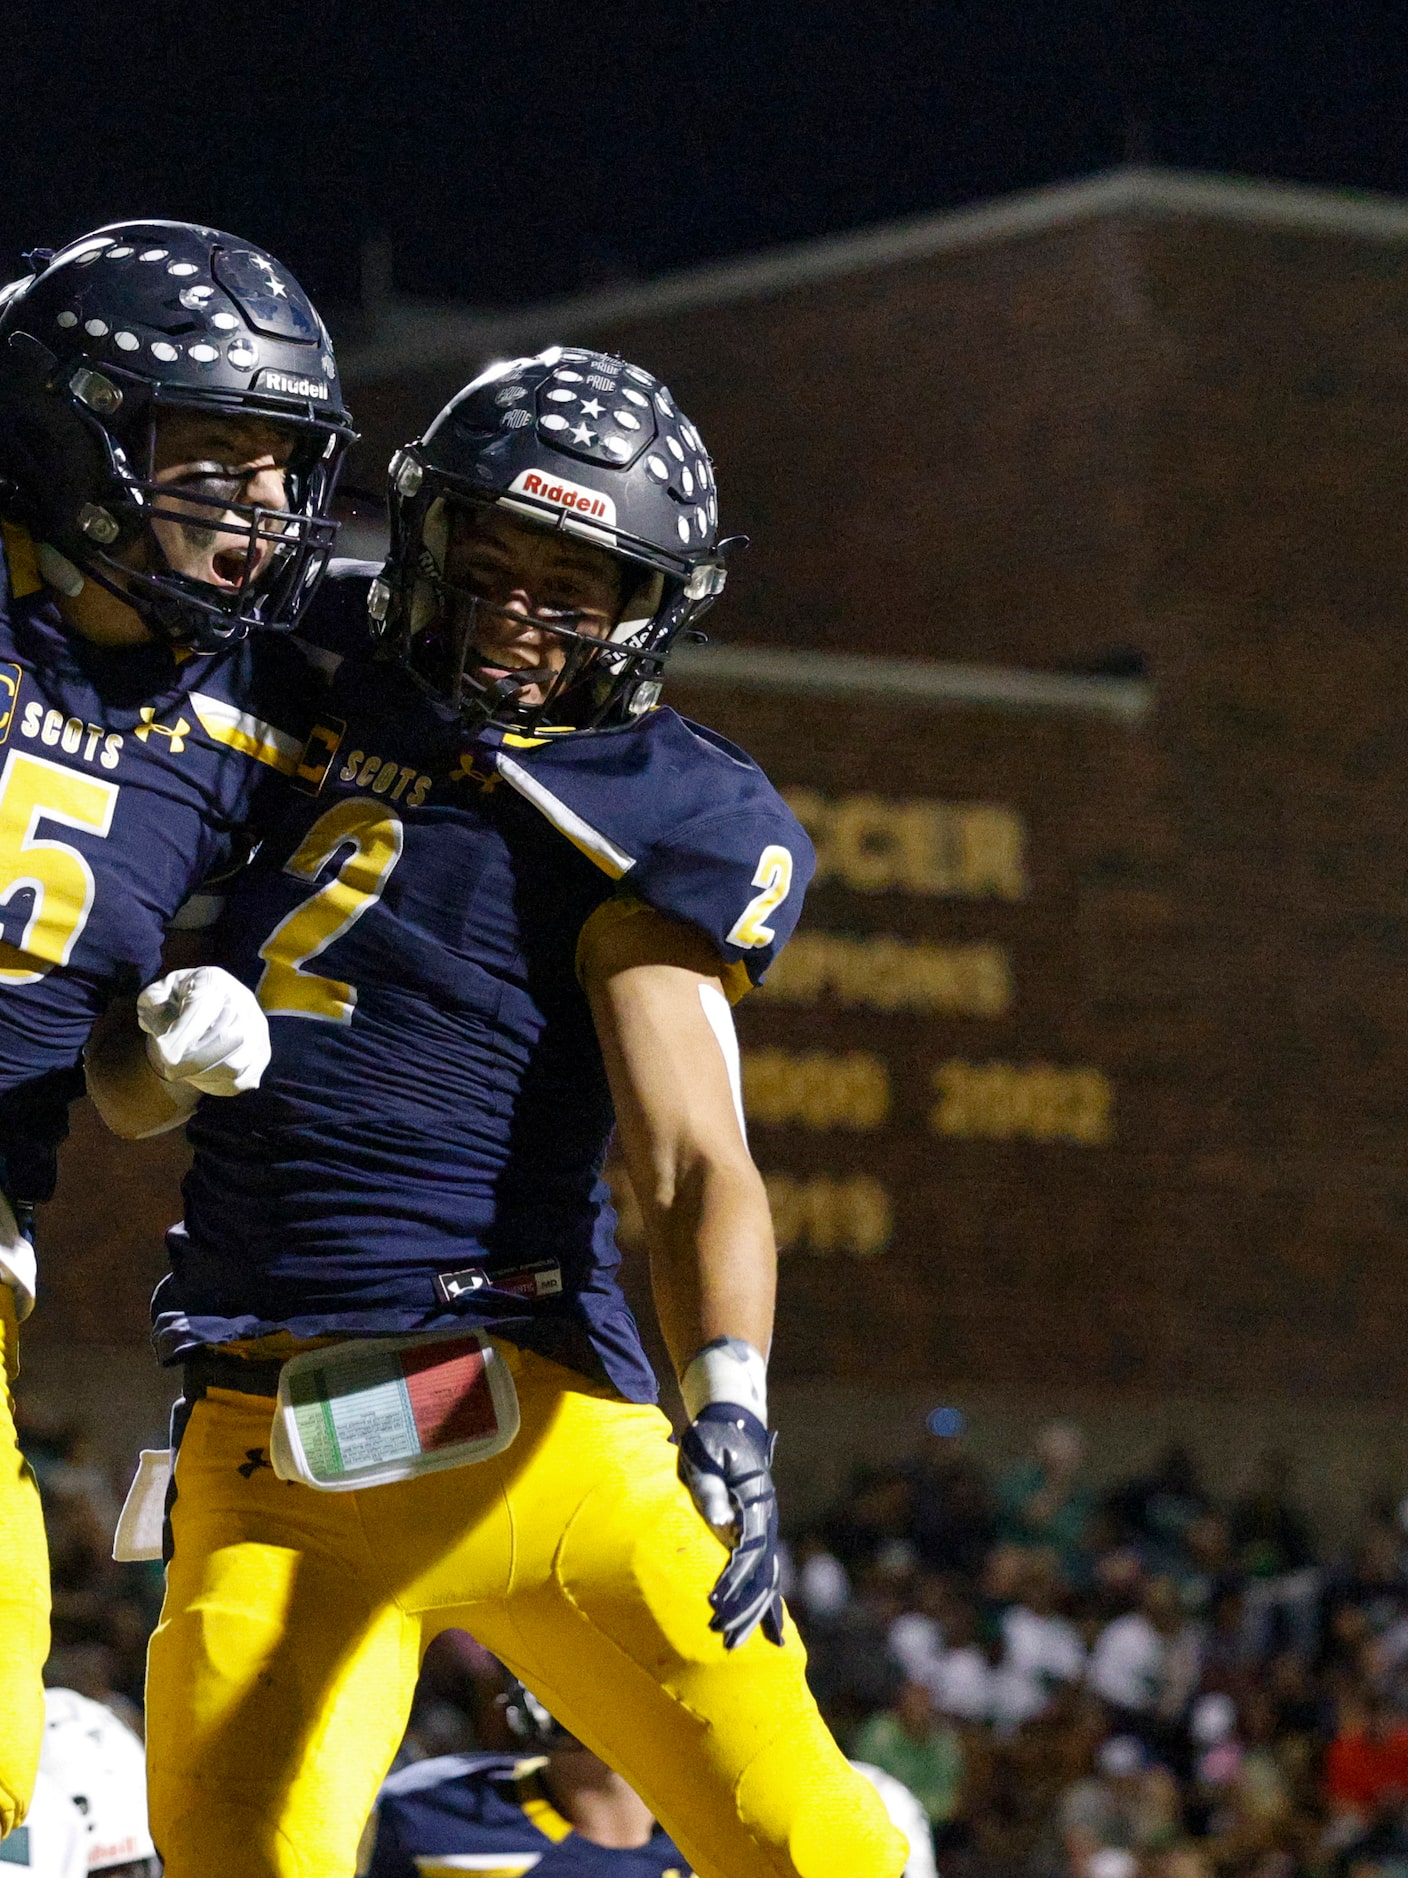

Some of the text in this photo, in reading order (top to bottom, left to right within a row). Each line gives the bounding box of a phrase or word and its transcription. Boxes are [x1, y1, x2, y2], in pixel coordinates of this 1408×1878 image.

[266, 372, 328, 400] Riddell
[586, 375, 616, 392] PRIDE
[502, 409, 532, 429] PRIDE
[523, 473, 606, 518] Riddell
[21, 701, 124, 769] SCOTS
[339, 750, 433, 806] SCOTS
[256, 796, 404, 1026] 2
[725, 845, 793, 949] 2
